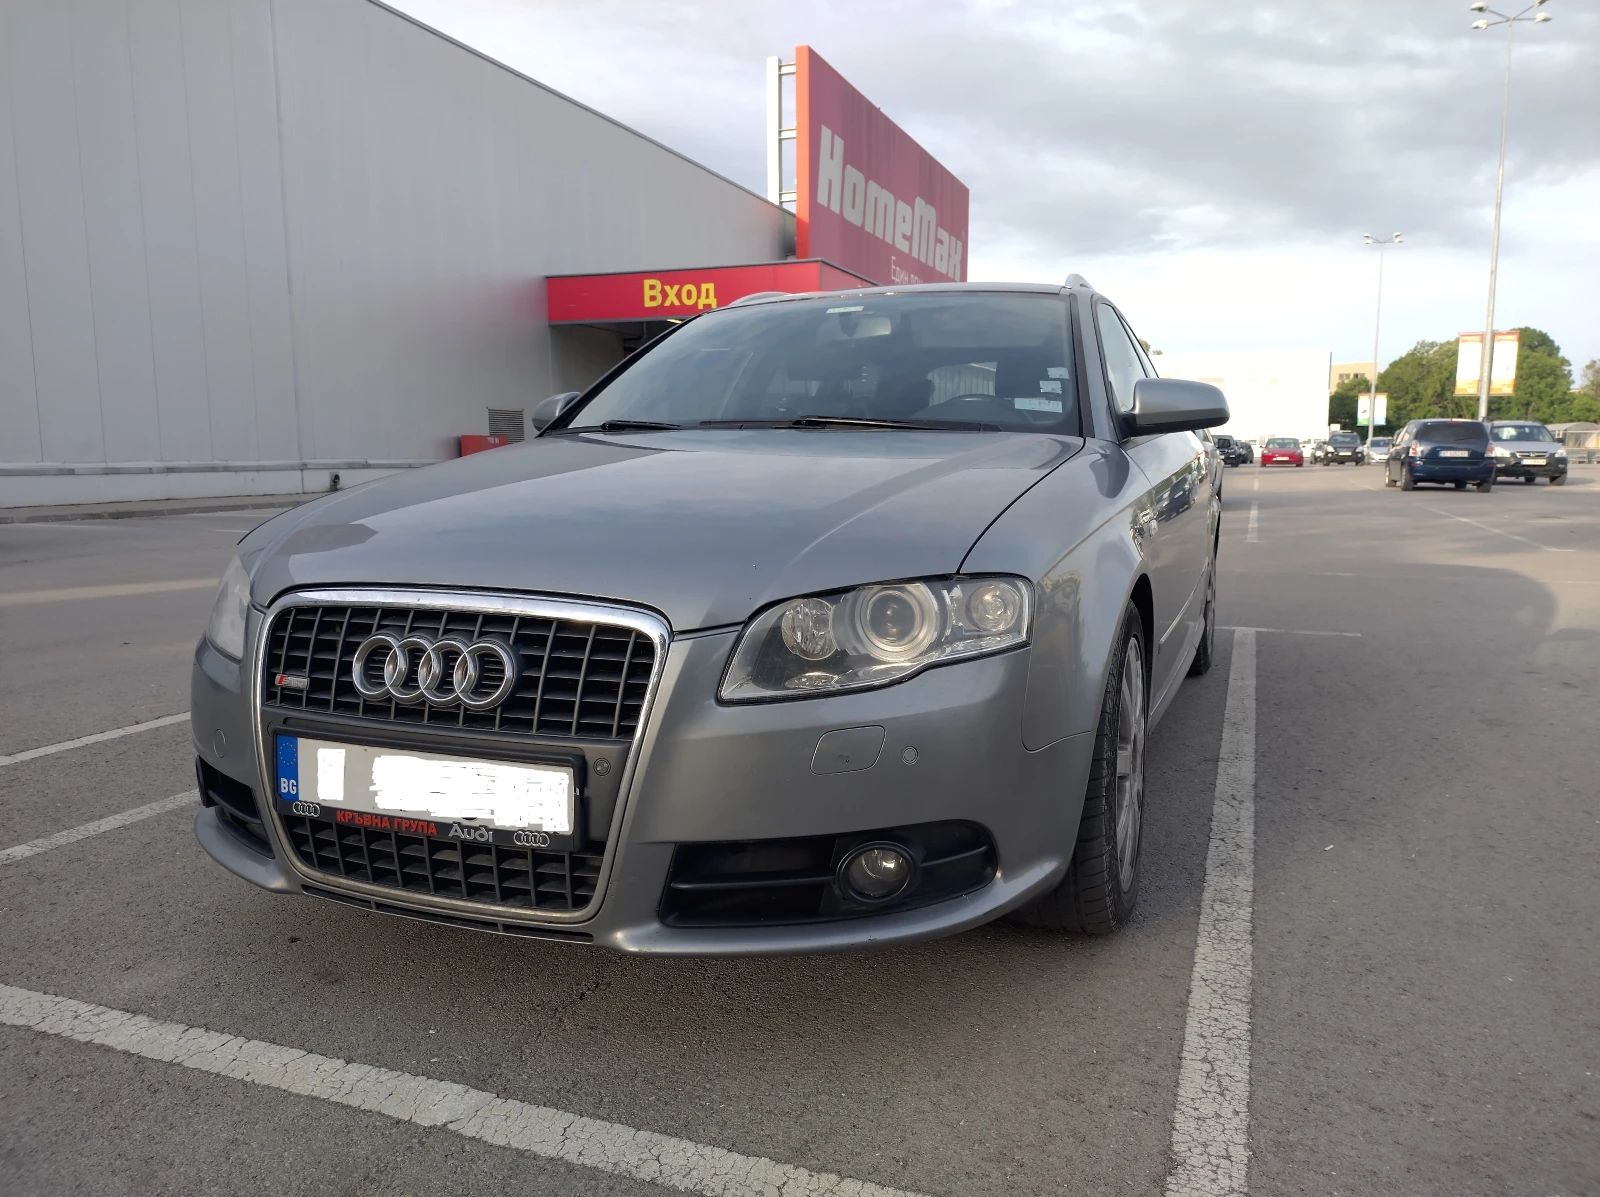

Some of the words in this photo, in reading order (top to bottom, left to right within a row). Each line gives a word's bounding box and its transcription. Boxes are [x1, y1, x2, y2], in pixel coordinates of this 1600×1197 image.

[817, 124, 963, 282] HomeMax
[643, 278, 718, 310] Вход
[280, 777, 297, 795] BG
[336, 809, 391, 829] КРЪВНА
[394, 818, 438, 836] ГРУПА
[448, 823, 494, 843] Audi
